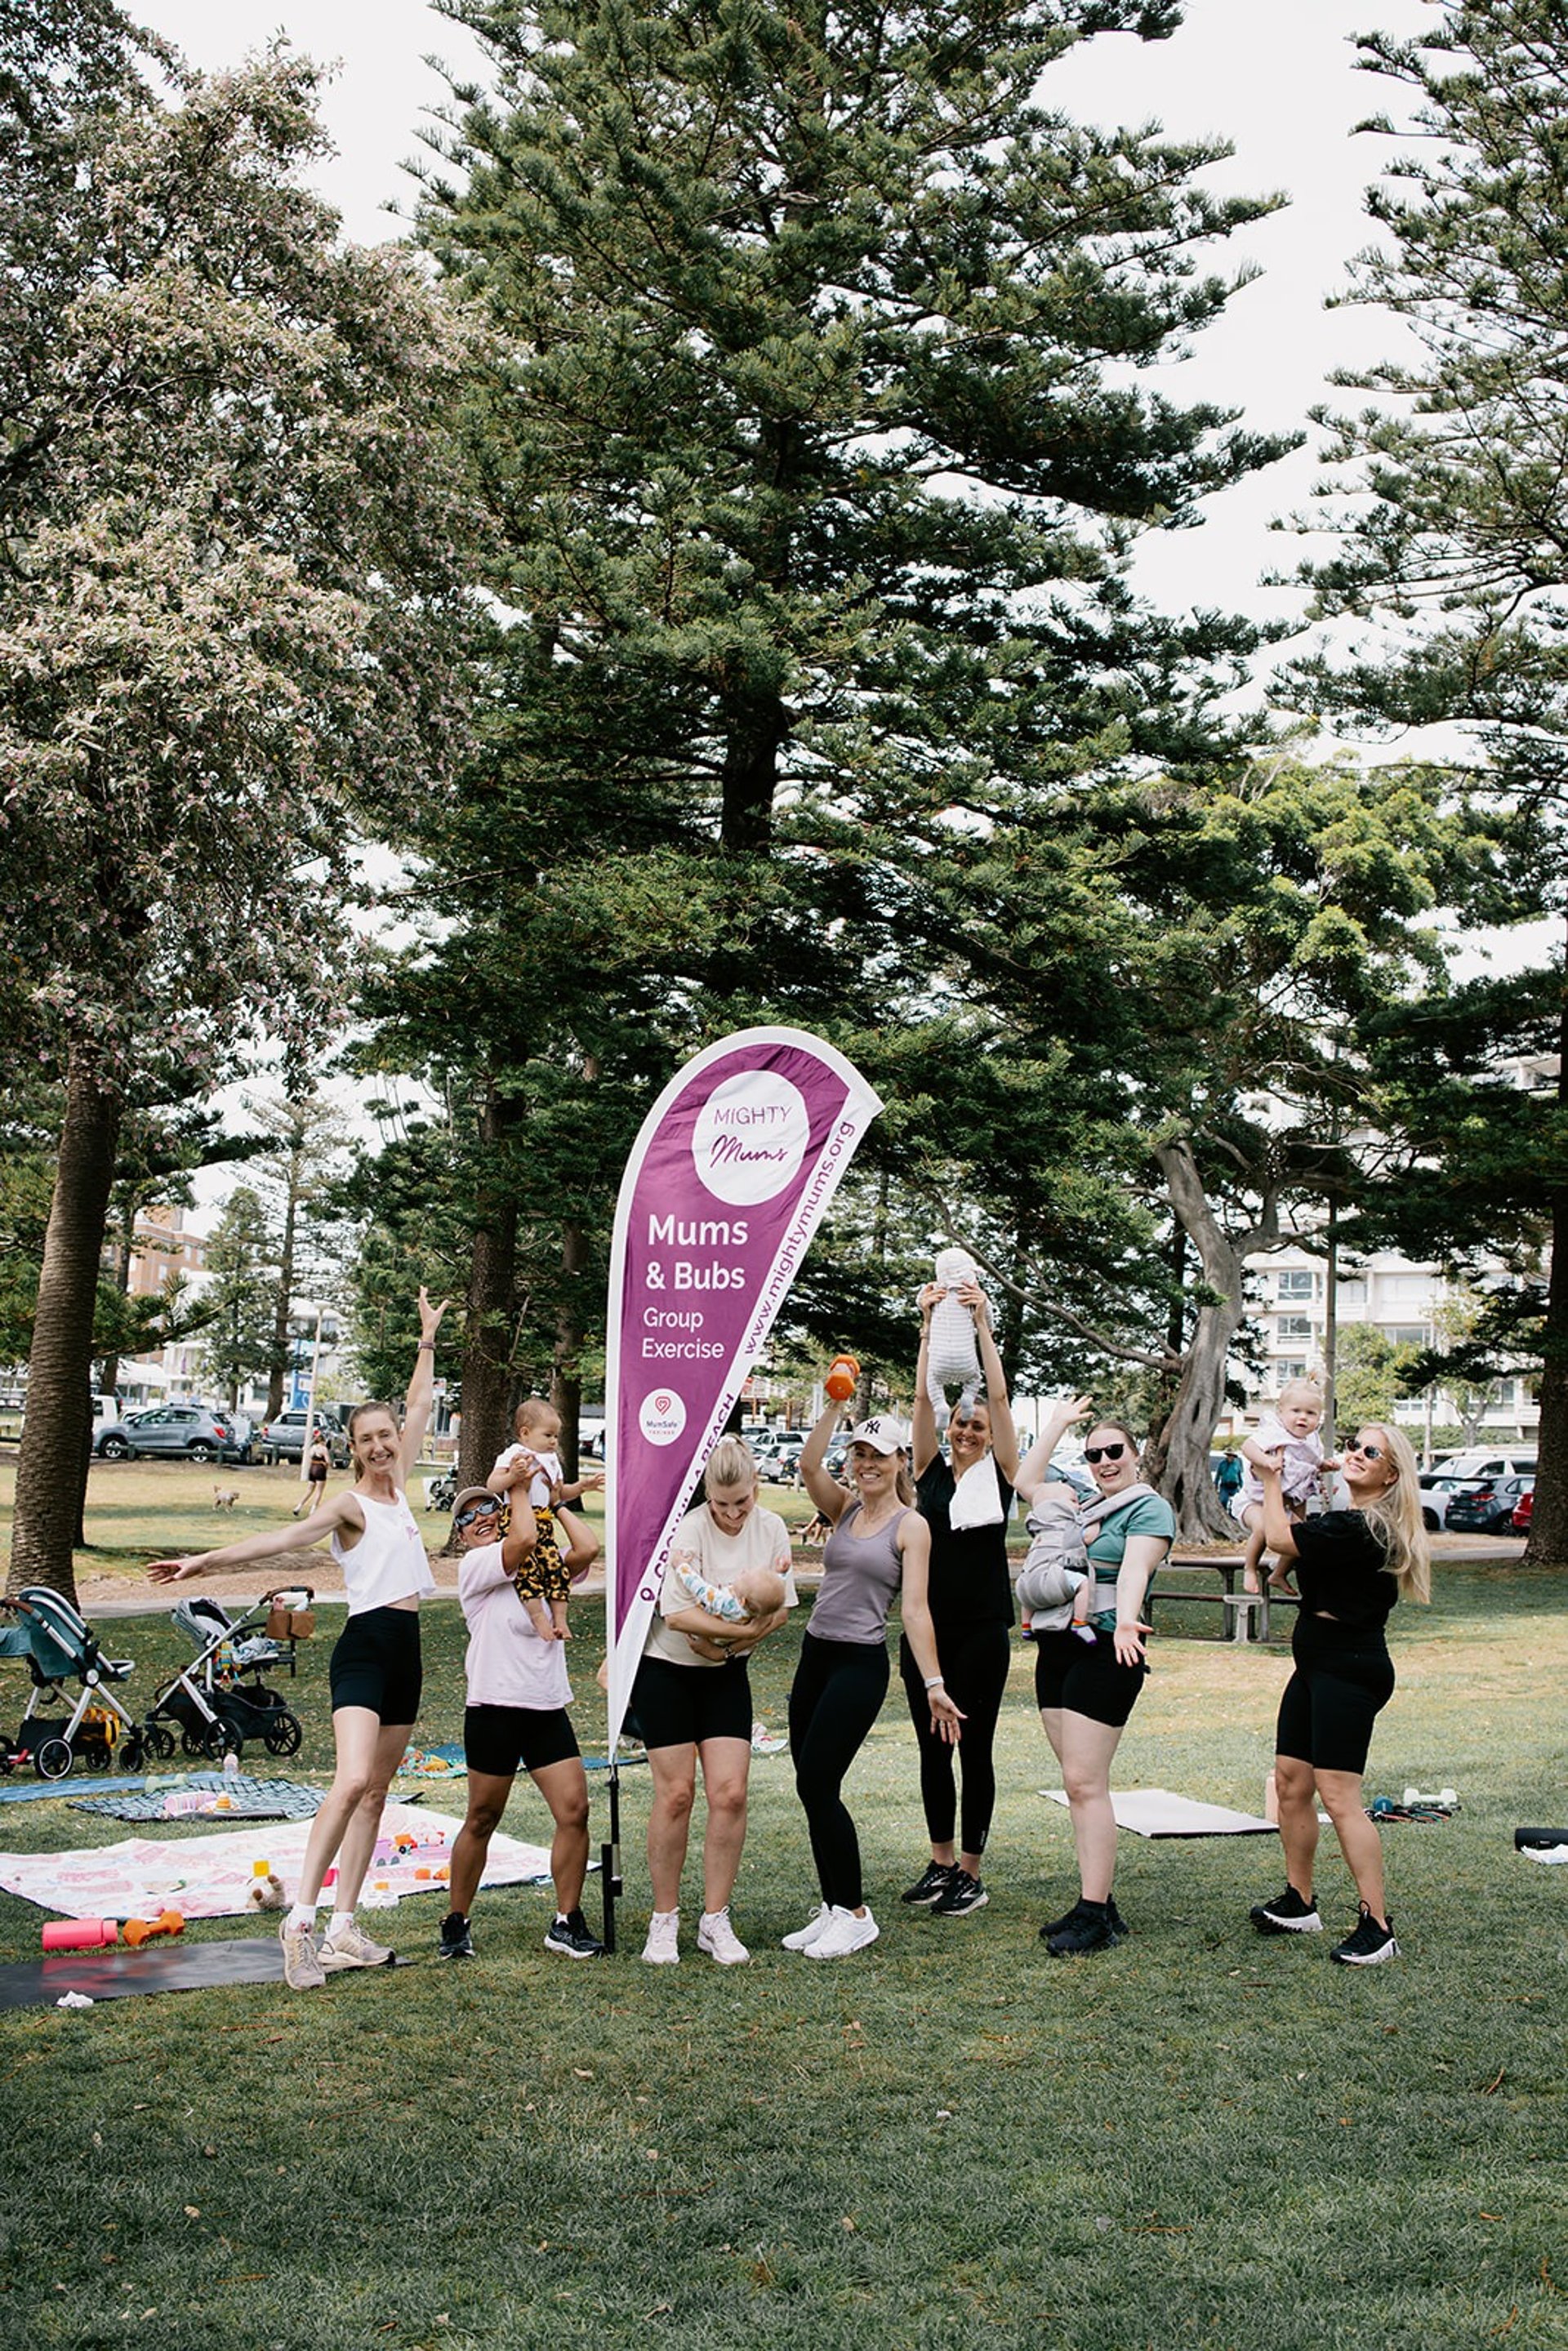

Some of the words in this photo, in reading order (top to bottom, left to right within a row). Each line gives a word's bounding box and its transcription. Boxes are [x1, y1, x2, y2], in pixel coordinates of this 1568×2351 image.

[715, 1106, 791, 1124] MIGHTY
[710, 1134, 788, 1168] Mums
[648, 1214, 748, 1246] Mums
[745, 1121, 855, 1354] www.mightymums.org
[646, 1262, 666, 1289] &
[675, 1261, 745, 1289] Bubs
[644, 1307, 703, 1333] Group
[642, 1338, 724, 1359] Exercise
[865, 1420, 881, 1434] NY
